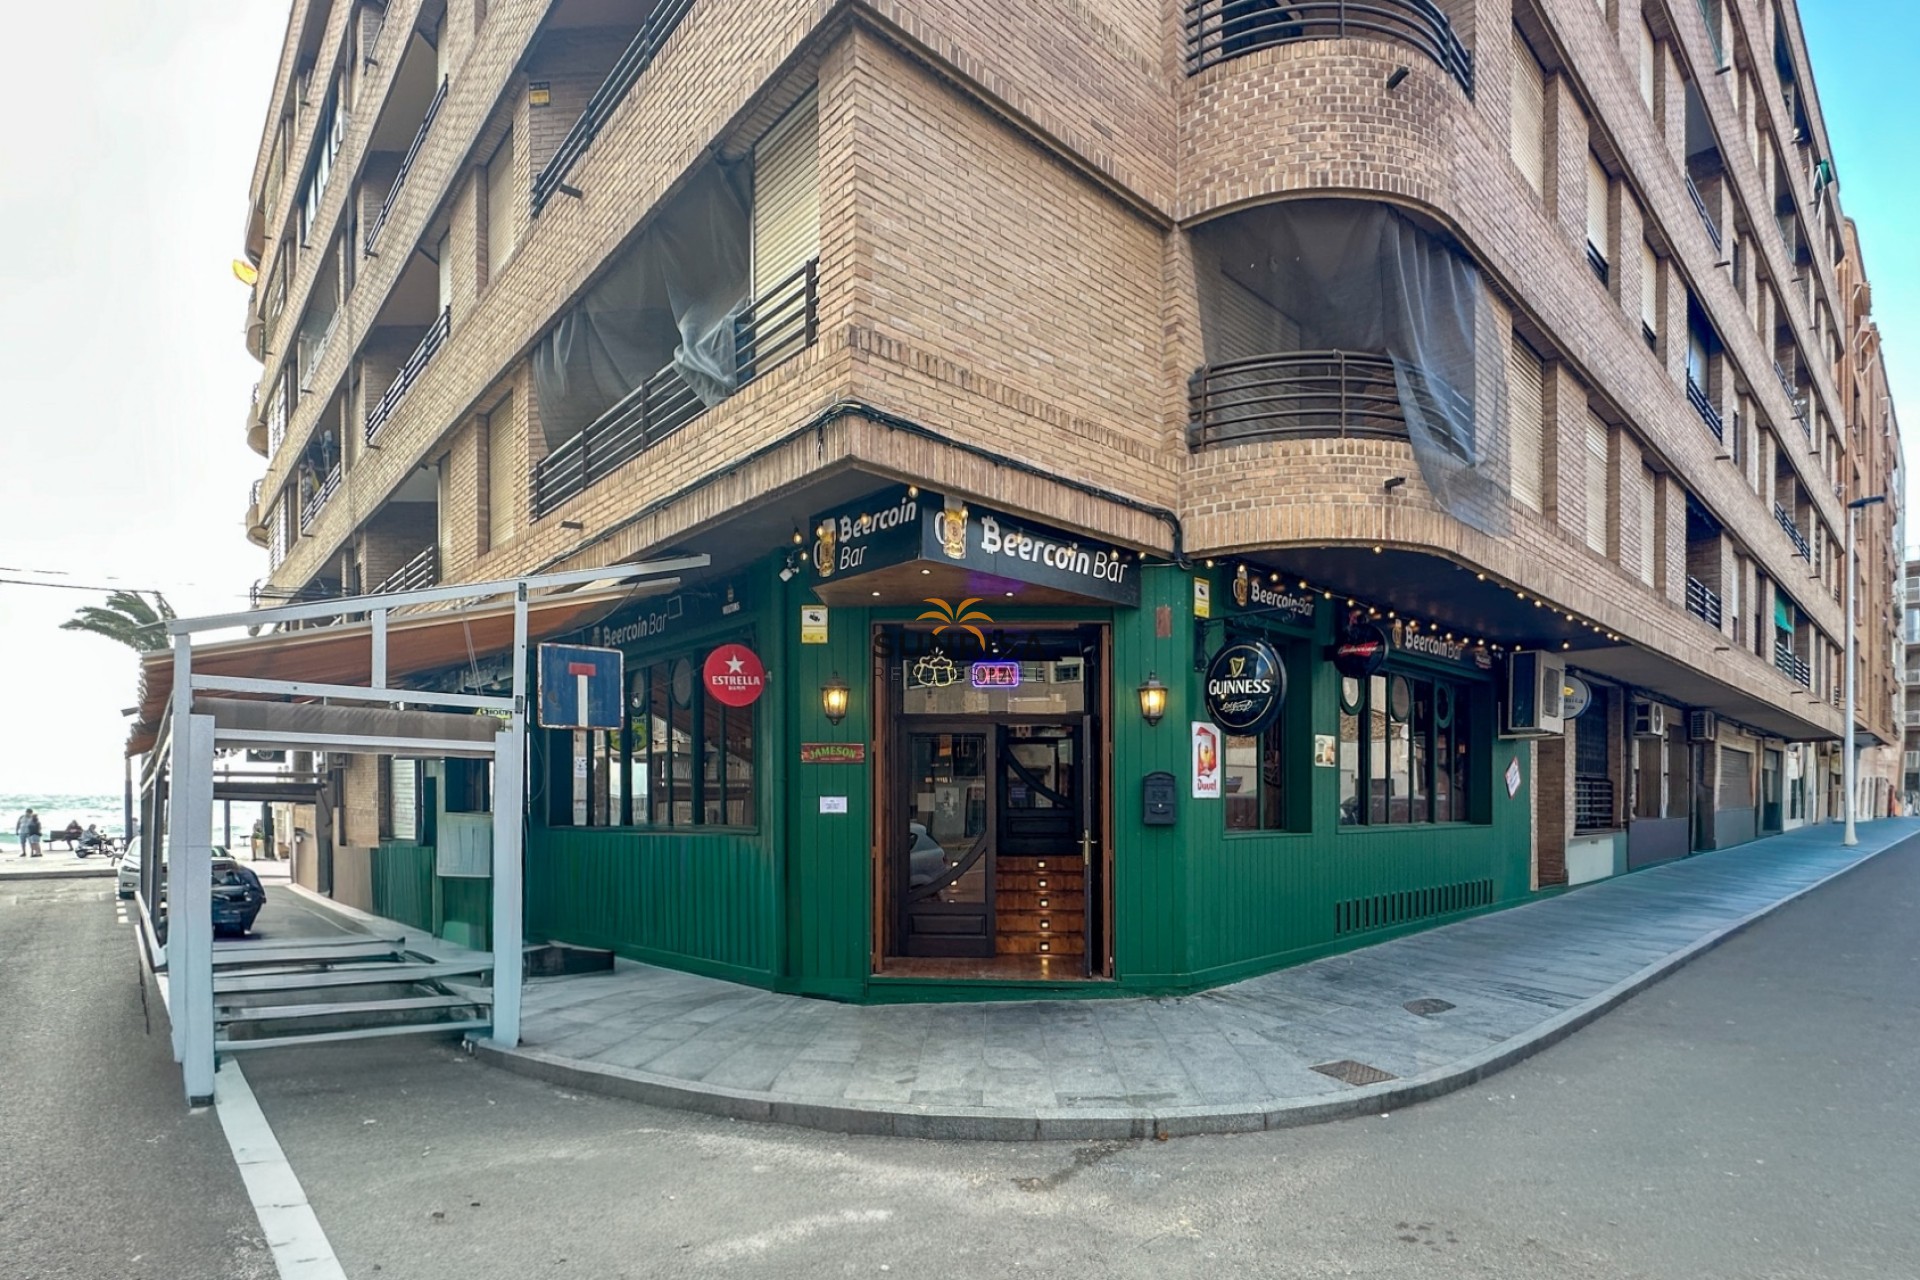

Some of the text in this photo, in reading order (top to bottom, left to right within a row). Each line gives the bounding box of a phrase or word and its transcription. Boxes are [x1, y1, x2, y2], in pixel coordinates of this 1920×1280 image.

[839, 497, 917, 543] Beercoin
[839, 546, 867, 570] Bar
[981, 515, 1128, 583] Beercoin Bar
[1250, 581, 1314, 616] Beercoin Bar
[603, 612, 667, 649] Beercoin Bar
[1405, 625, 1448, 657] Beercoin
[712, 675, 760, 686] ESTRELLA
[975, 665, 1016, 685] OPEN
[1208, 678, 1271, 695] GUINNESS
[809, 746, 857, 760] JAMESON
[1197, 778, 1216, 791] Duvel
